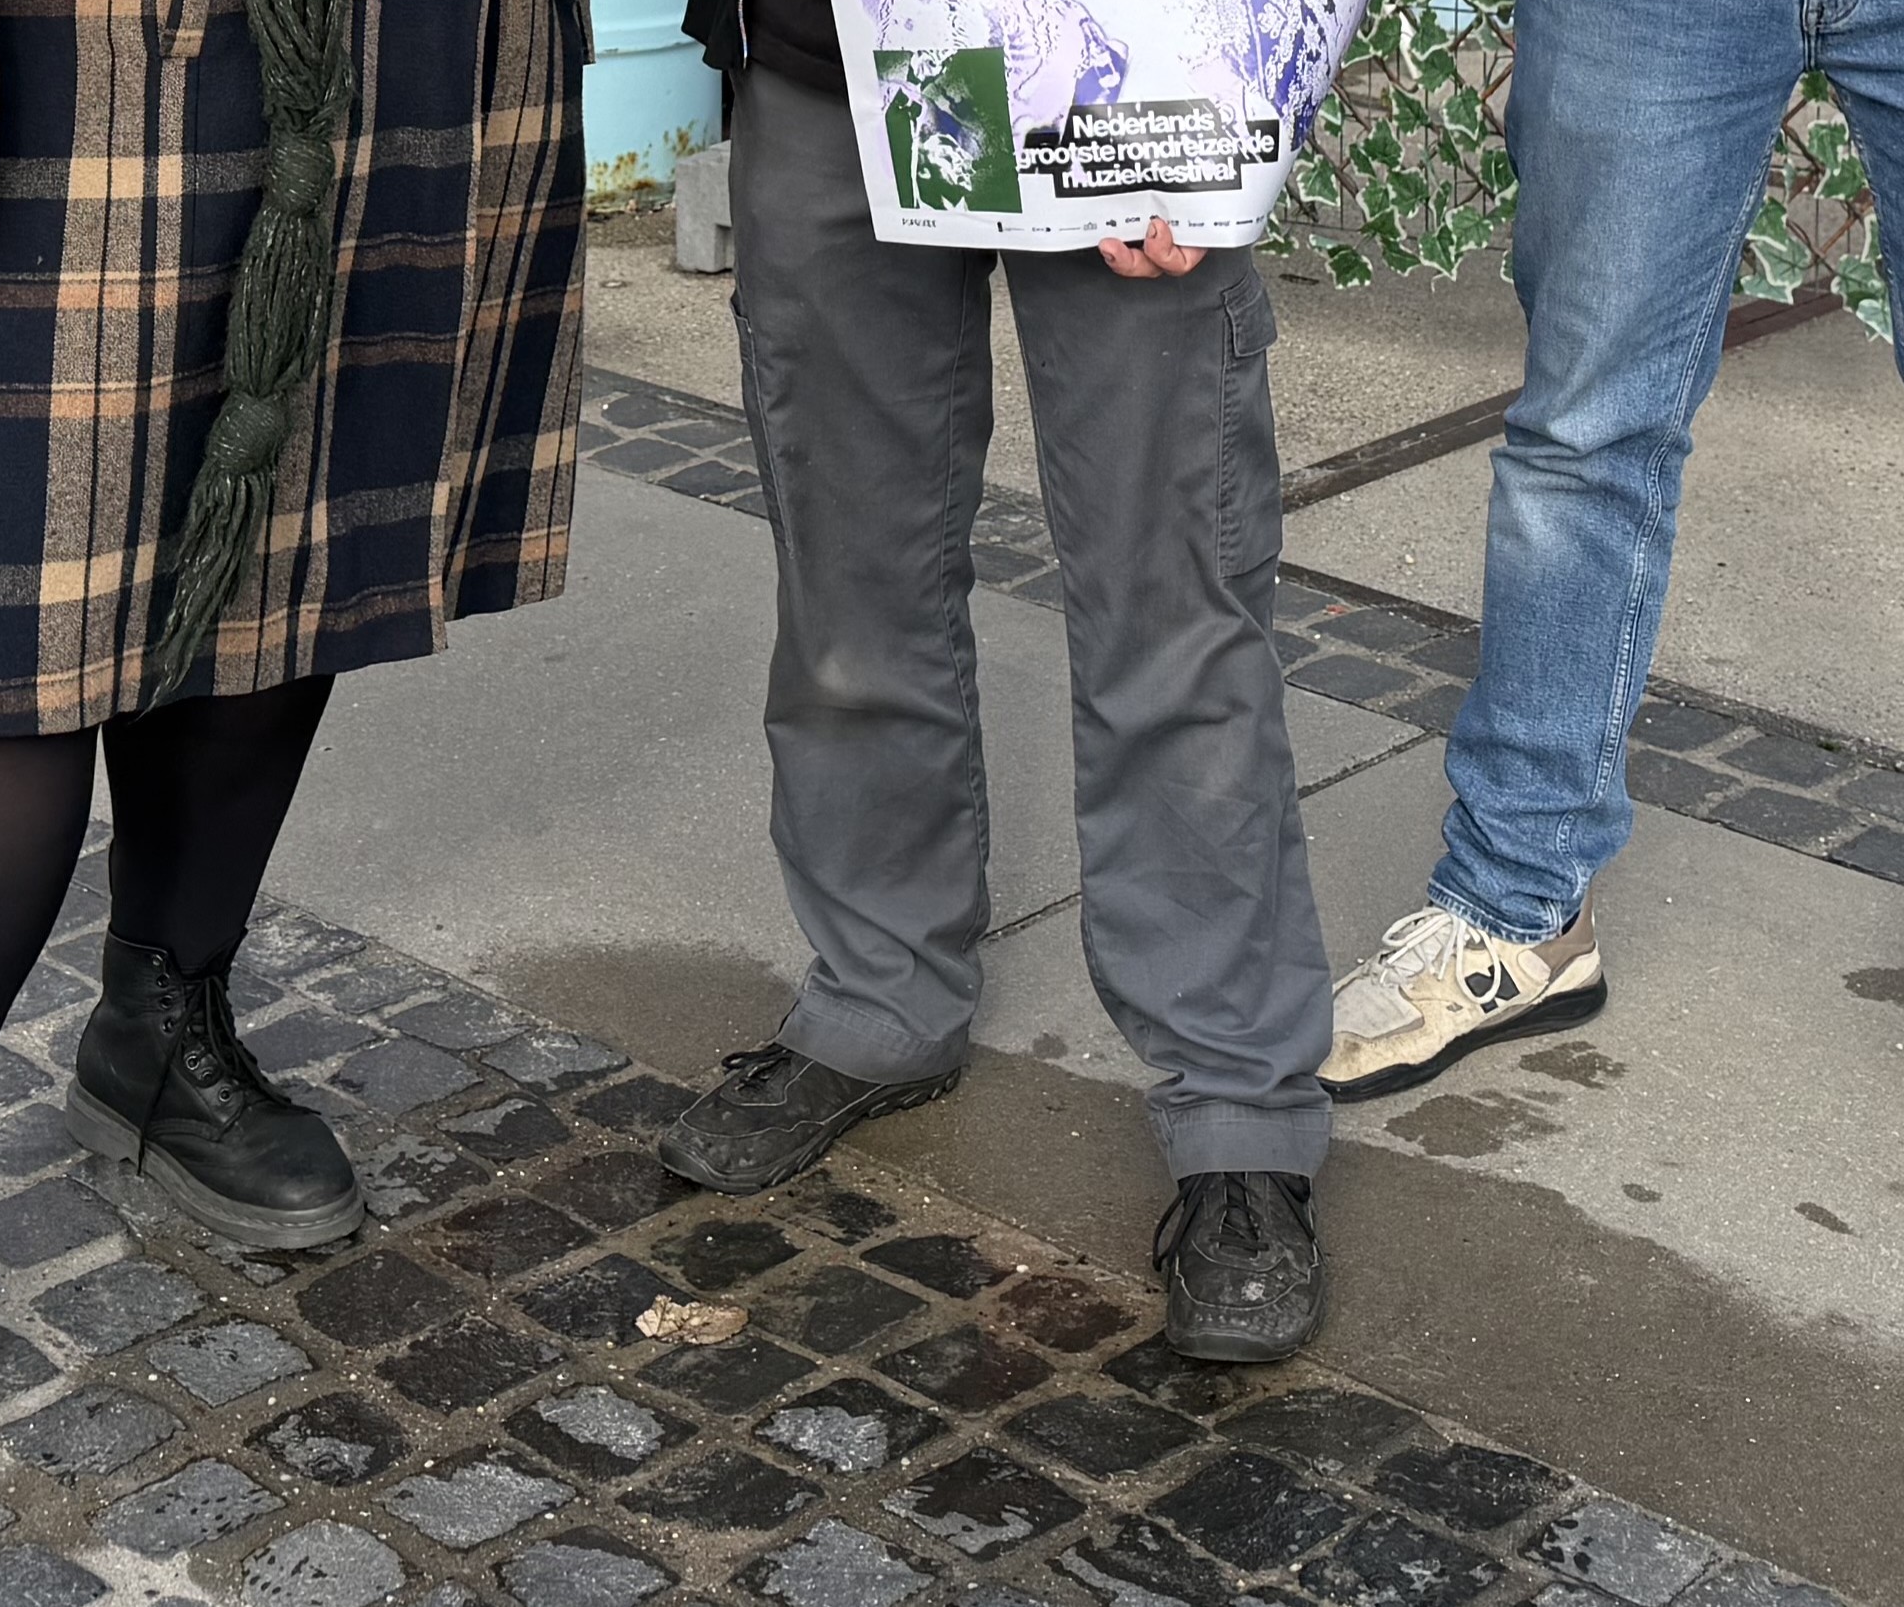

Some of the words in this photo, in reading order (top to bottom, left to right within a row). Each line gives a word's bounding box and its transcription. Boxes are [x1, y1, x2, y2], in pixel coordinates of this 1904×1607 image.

[1072, 108, 1216, 140] Nederlands
[1015, 141, 1116, 170] grootste
[1117, 129, 1276, 161] rondreizende
[1062, 156, 1238, 190] muziekfestival
